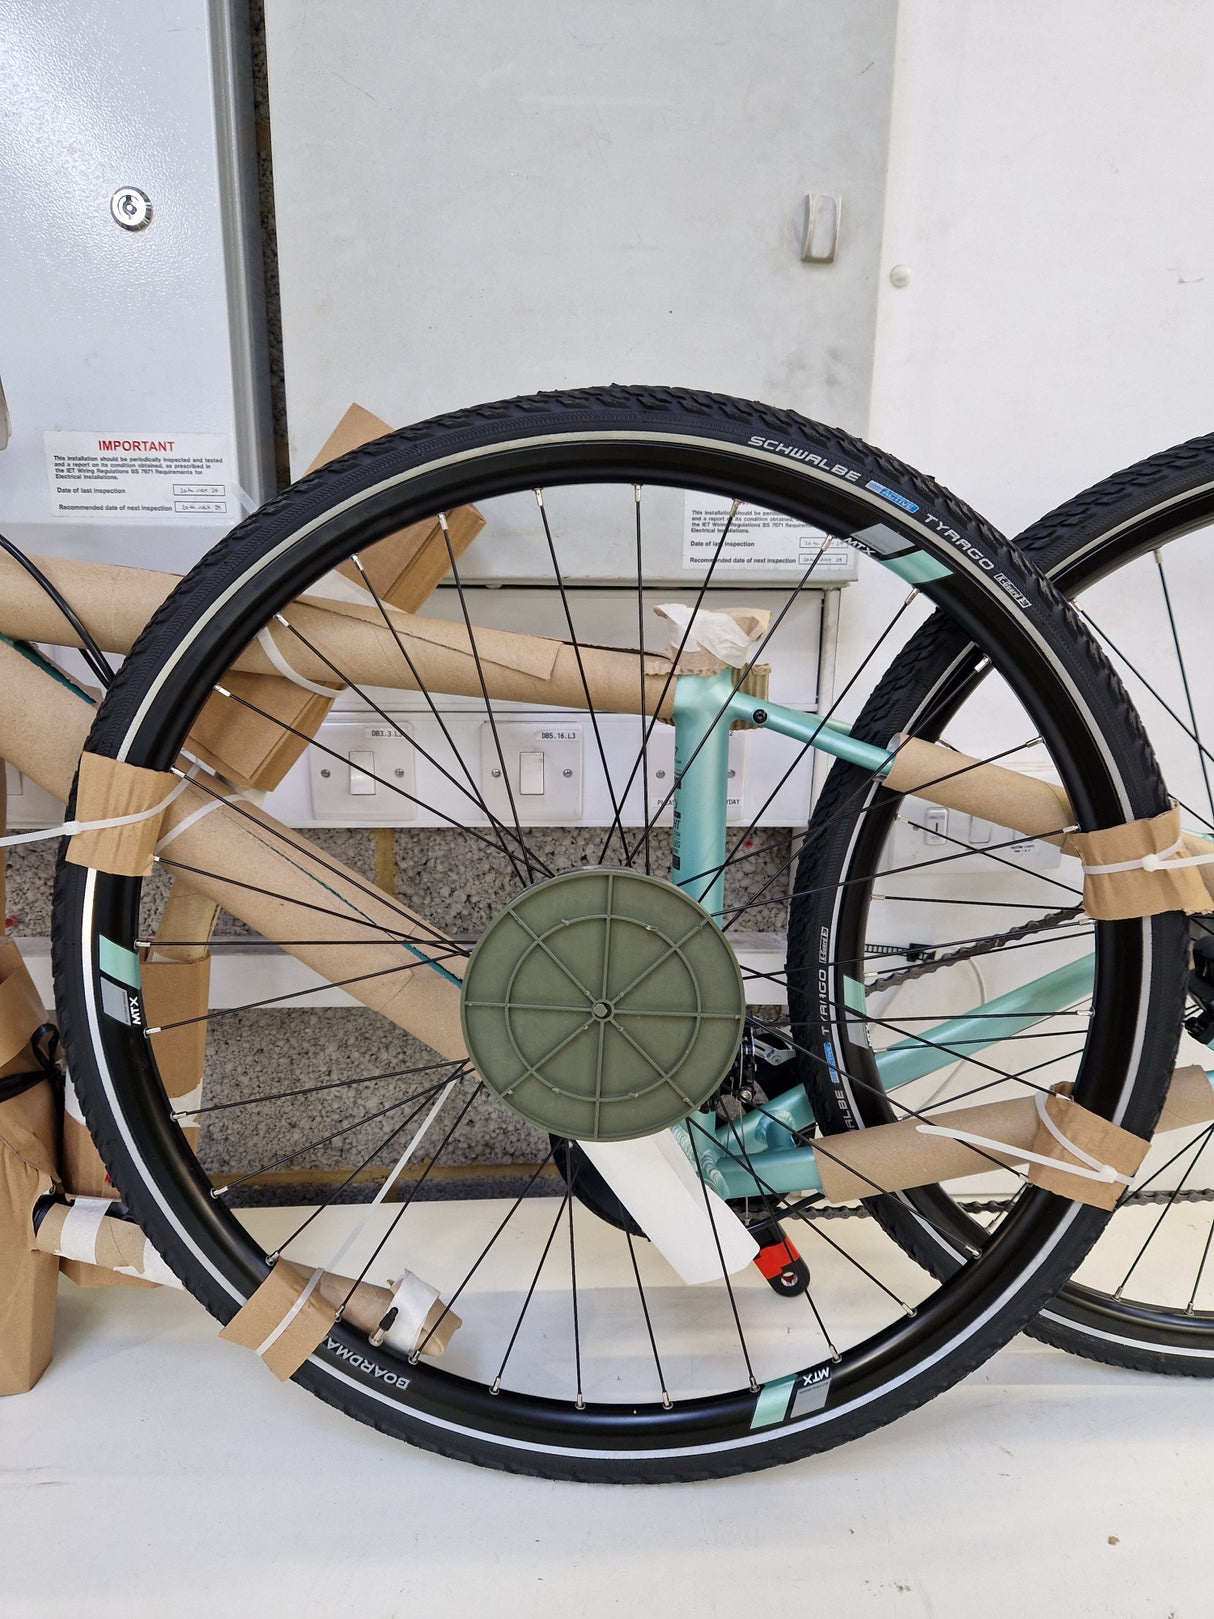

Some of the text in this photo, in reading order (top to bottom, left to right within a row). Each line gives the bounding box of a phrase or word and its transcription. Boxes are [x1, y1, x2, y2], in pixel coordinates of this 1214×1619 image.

[98, 440, 175, 452] IMPORTANT
[748, 435, 861, 481] SCHWALBE
[883, 489, 915, 511] ACTIVE
[924, 513, 994, 570] TYRAGO
[844, 537, 876, 555] MTX
[541, 732, 576, 740] DB5.16.L3
[129, 996, 142, 1025] MTX
[803, 1366, 830, 1387] MTX
